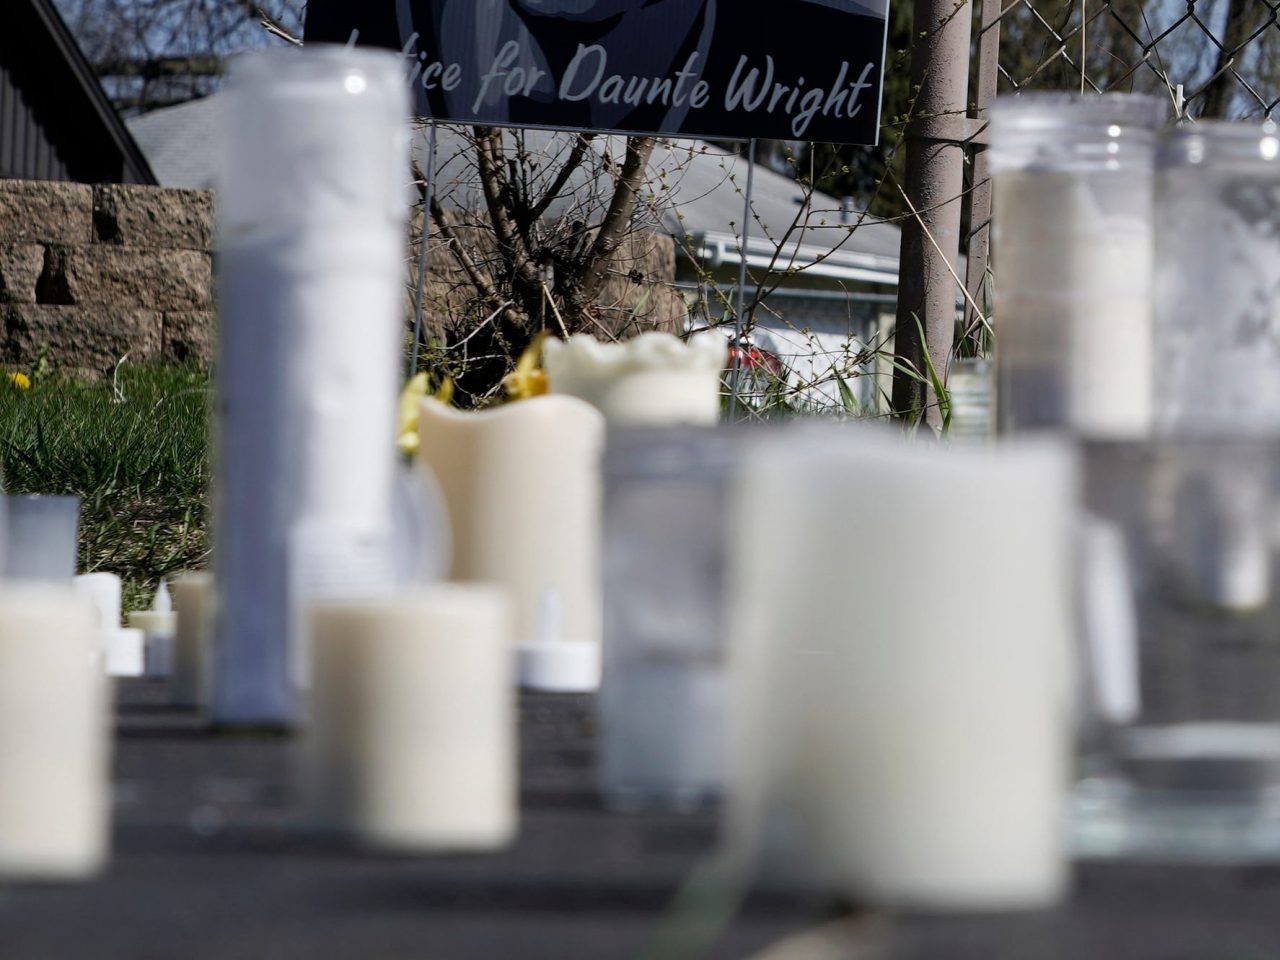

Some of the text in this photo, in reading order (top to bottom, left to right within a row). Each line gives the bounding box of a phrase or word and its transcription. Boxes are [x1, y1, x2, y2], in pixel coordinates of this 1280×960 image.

[473, 40, 546, 114] for
[558, 43, 710, 109] Daunte
[724, 54, 874, 137] Wright
